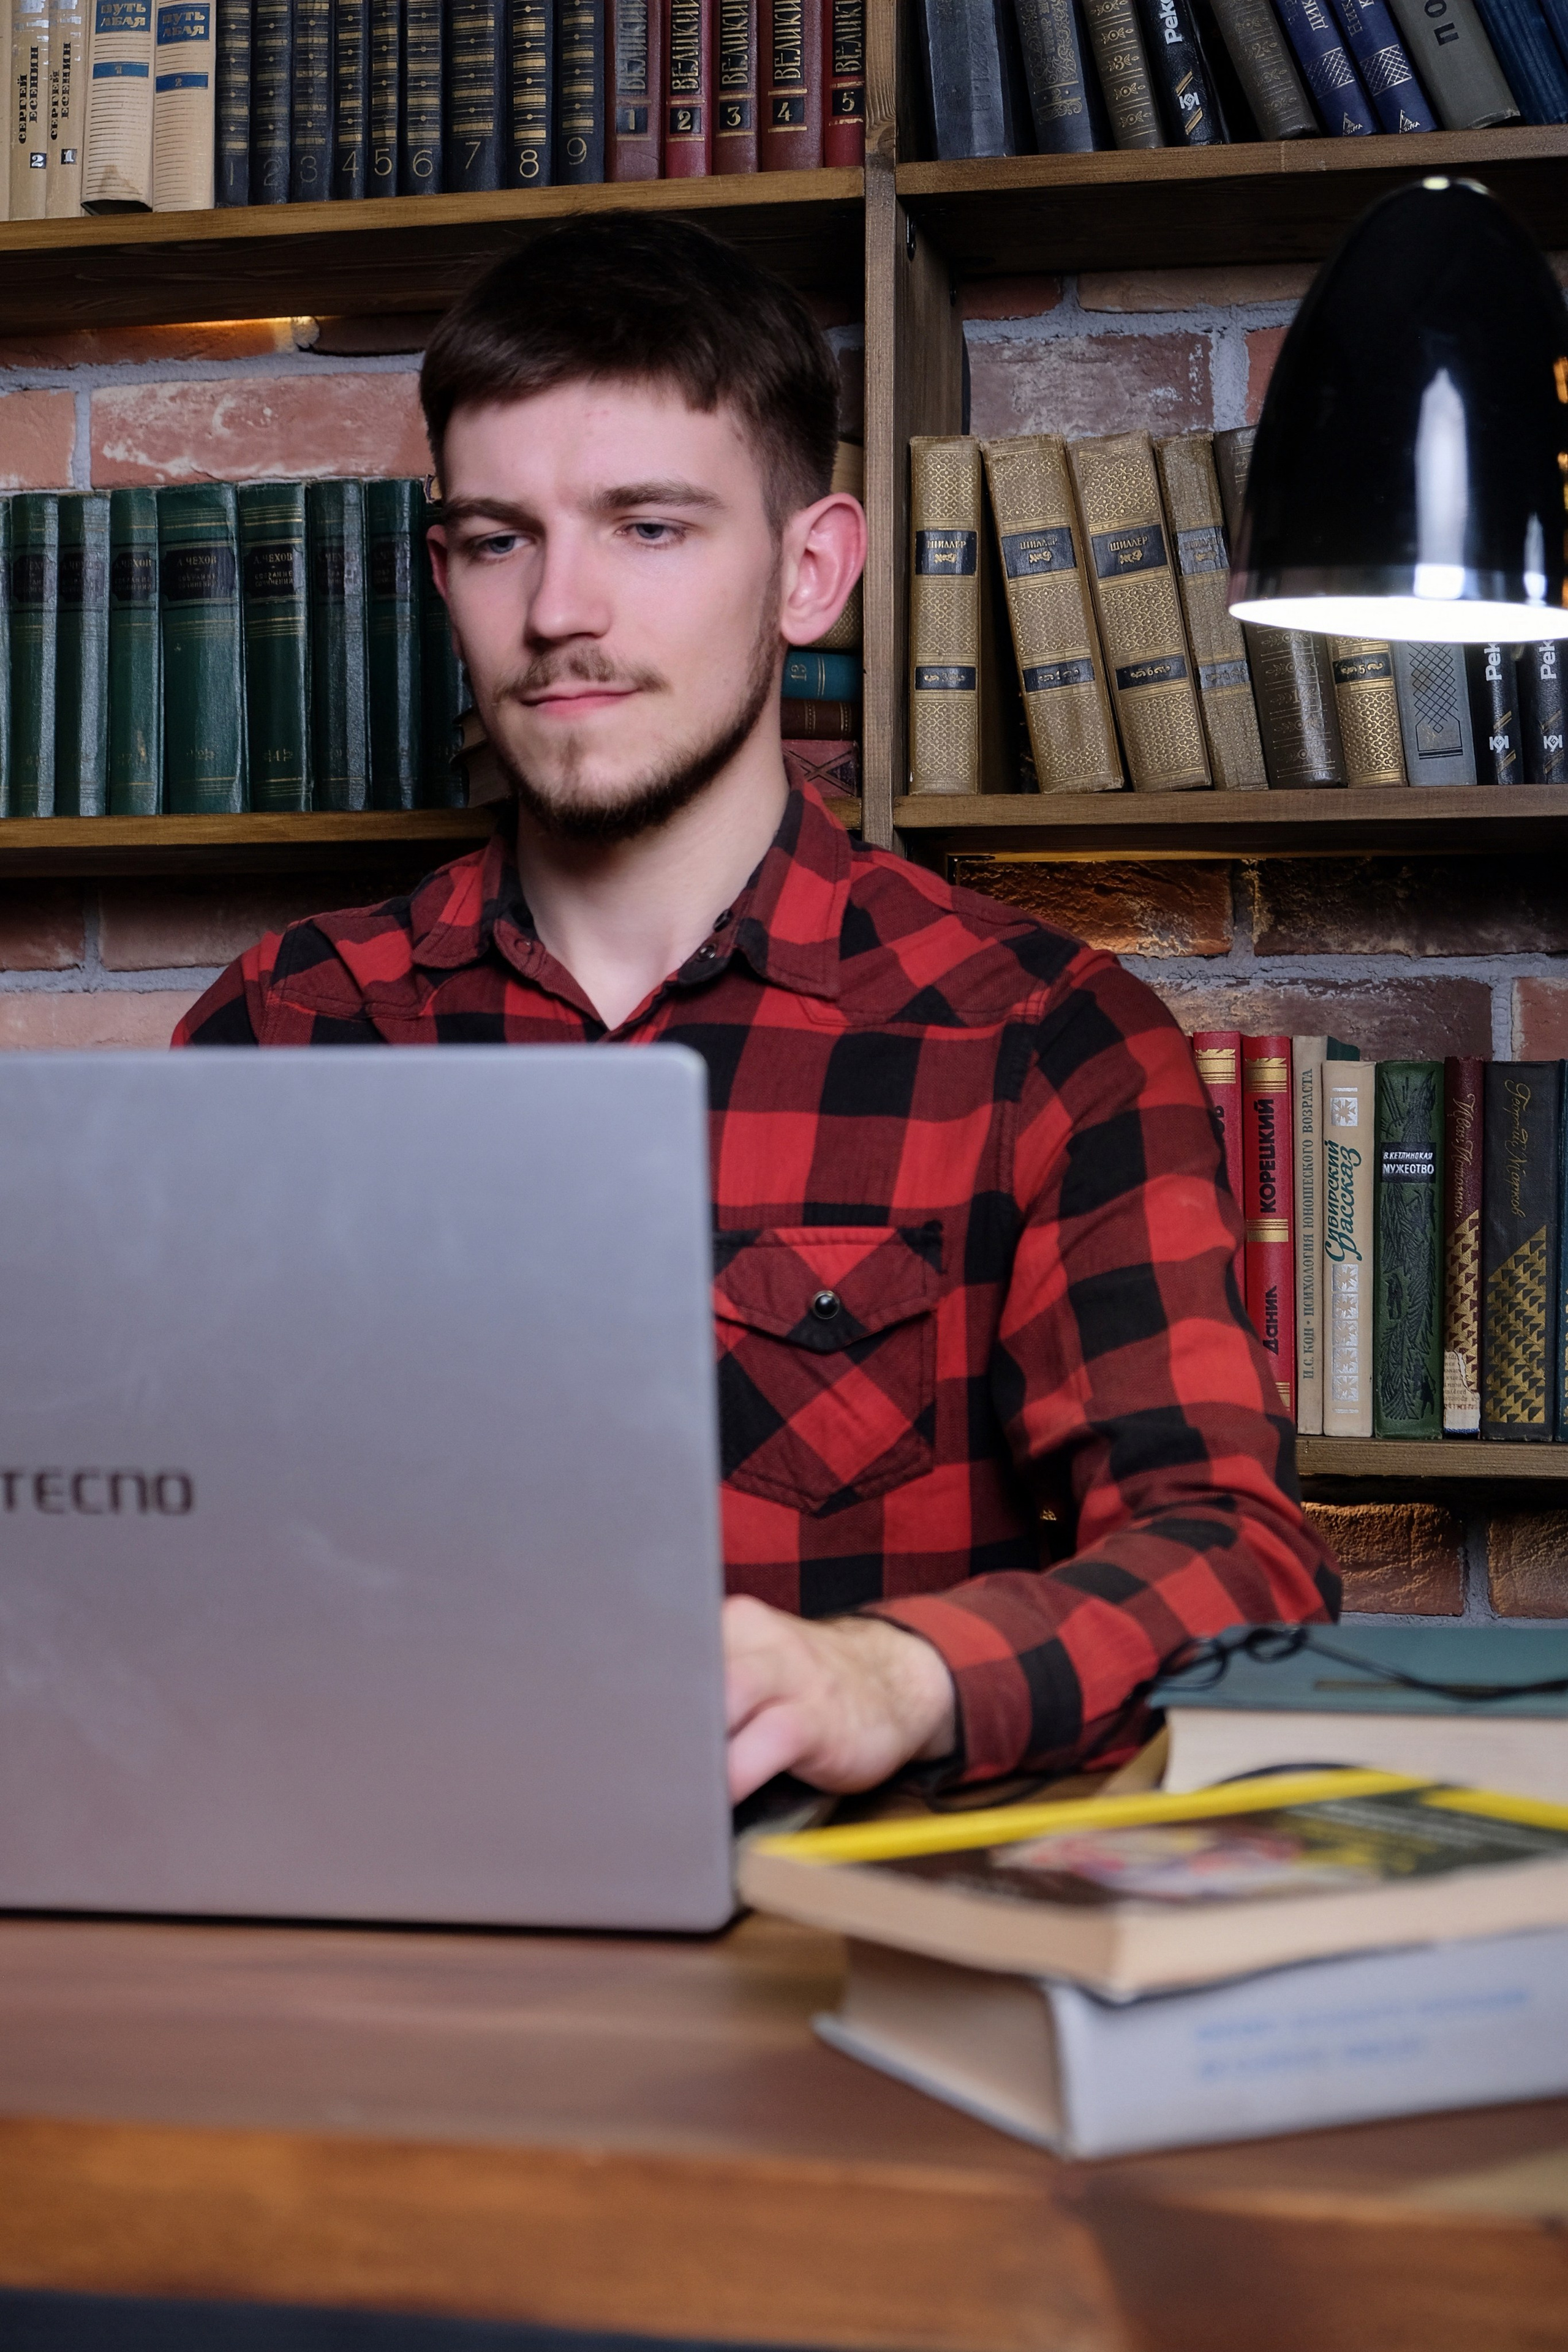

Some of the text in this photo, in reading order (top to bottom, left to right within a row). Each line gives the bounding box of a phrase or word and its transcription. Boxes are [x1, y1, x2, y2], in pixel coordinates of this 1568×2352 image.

[101, 3, 146, 16] ПУТЬ
[162, 12, 205, 24] ПУТЬ
[100, 17, 146, 28] АБАЯ
[162, 25, 205, 38] АБАЯ
[1252, 43, 1265, 59] 2
[115, 66, 123, 74] 1
[1114, 55, 1125, 70] 3
[29, 46, 39, 123] ЕСЕНИН
[61, 42, 71, 119] ЕСЕНИН
[175, 78, 183, 87] 2
[50, 70, 60, 140] СЕРГЕЙ
[842, 91, 855, 112] 5
[1052, 88, 1062, 102] 2
[17, 74, 27, 144] СЕРГЕЙ
[625, 109, 635, 130] 1
[727, 107, 741, 126] 3
[777, 102, 793, 121] 4
[677, 110, 692, 130] 2
[31, 154, 45, 167] 2
[63, 149, 75, 162] 1
[465, 141, 481, 170] 7
[567, 137, 587, 165] 9
[263, 159, 281, 186] 2
[300, 156, 318, 183] 3
[342, 151, 359, 178] 4
[374, 148, 393, 176] 5
[413, 149, 433, 178] 6
[519, 149, 540, 178] 8
[927, 540, 967, 549] ШИЛЛЕР
[1109, 536, 1148, 552] ШИЛЛЕР
[1359, 664, 1366, 674] 5
[1302, 1069, 1313, 1134] ВОЗРАСТА
[1254, 1098, 1276, 1213] КОРЕЦКИЙ
[1382, 1163, 1434, 1174] МУЖЕСТВО
[1302, 1139, 1314, 1229] ЮНОШЕСКОГО
[1302, 1233, 1314, 1316] ПСИХОЛОГИЯ
[1303, 1327, 1314, 1354] КОН
[0, 1467, 194, 1517] TECNO
